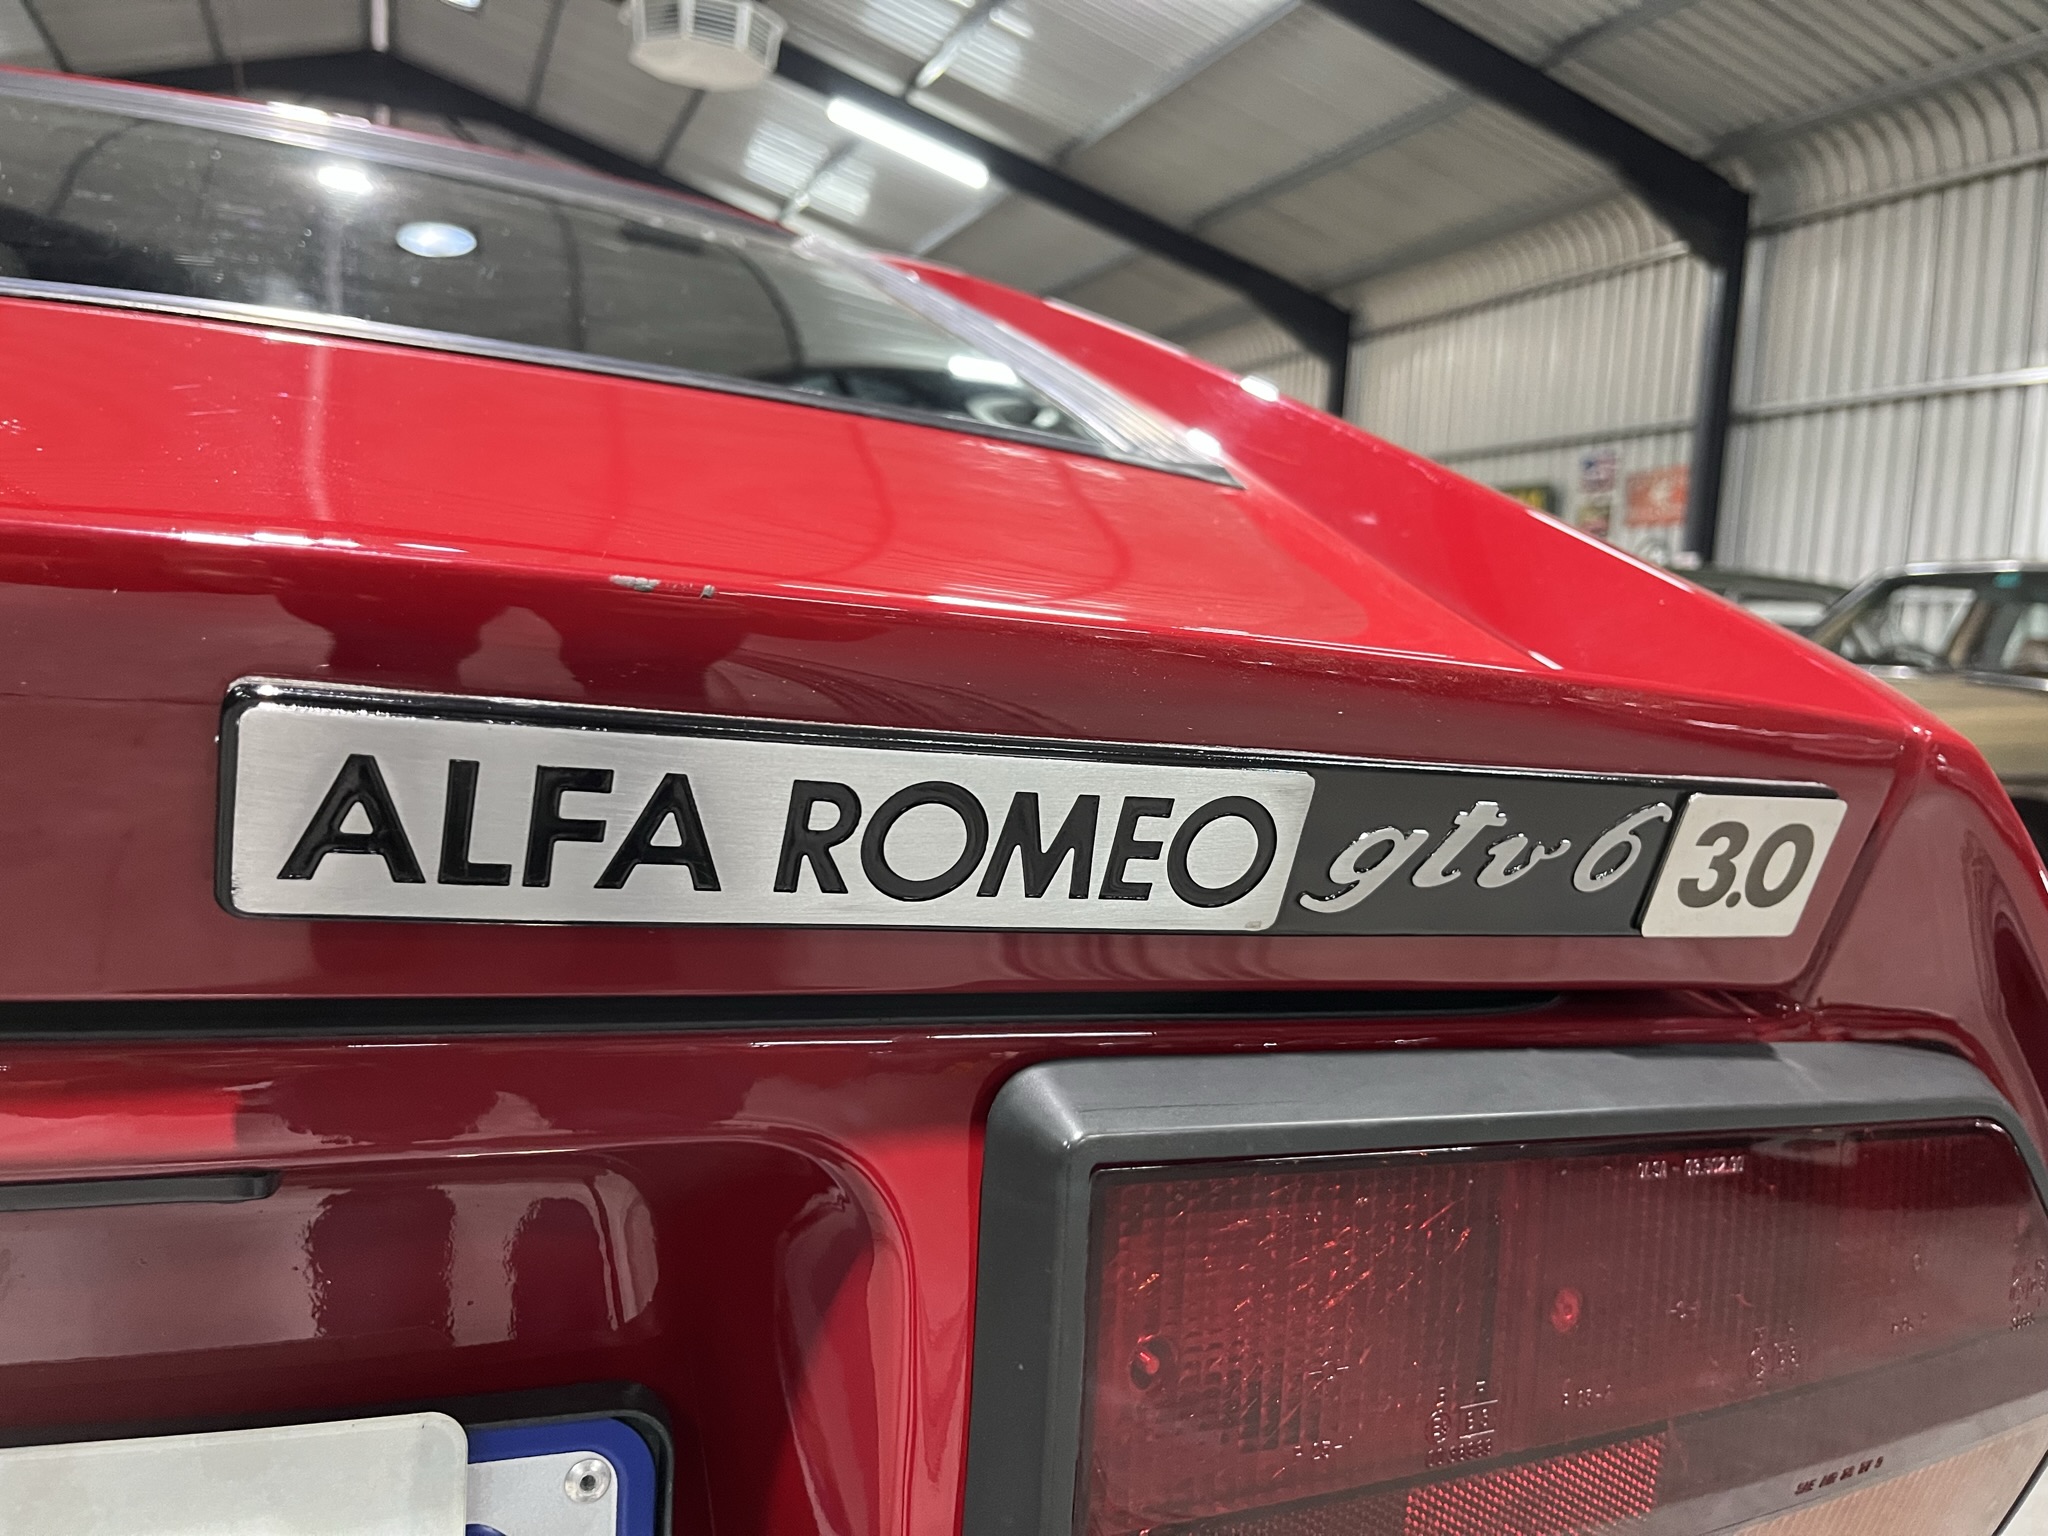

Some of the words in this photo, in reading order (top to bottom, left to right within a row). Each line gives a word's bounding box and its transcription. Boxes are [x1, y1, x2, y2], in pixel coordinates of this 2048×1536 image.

[276, 753, 721, 891] ALFA
[773, 779, 1277, 908] ROMEO
[1677, 819, 1815, 909] 3.0
